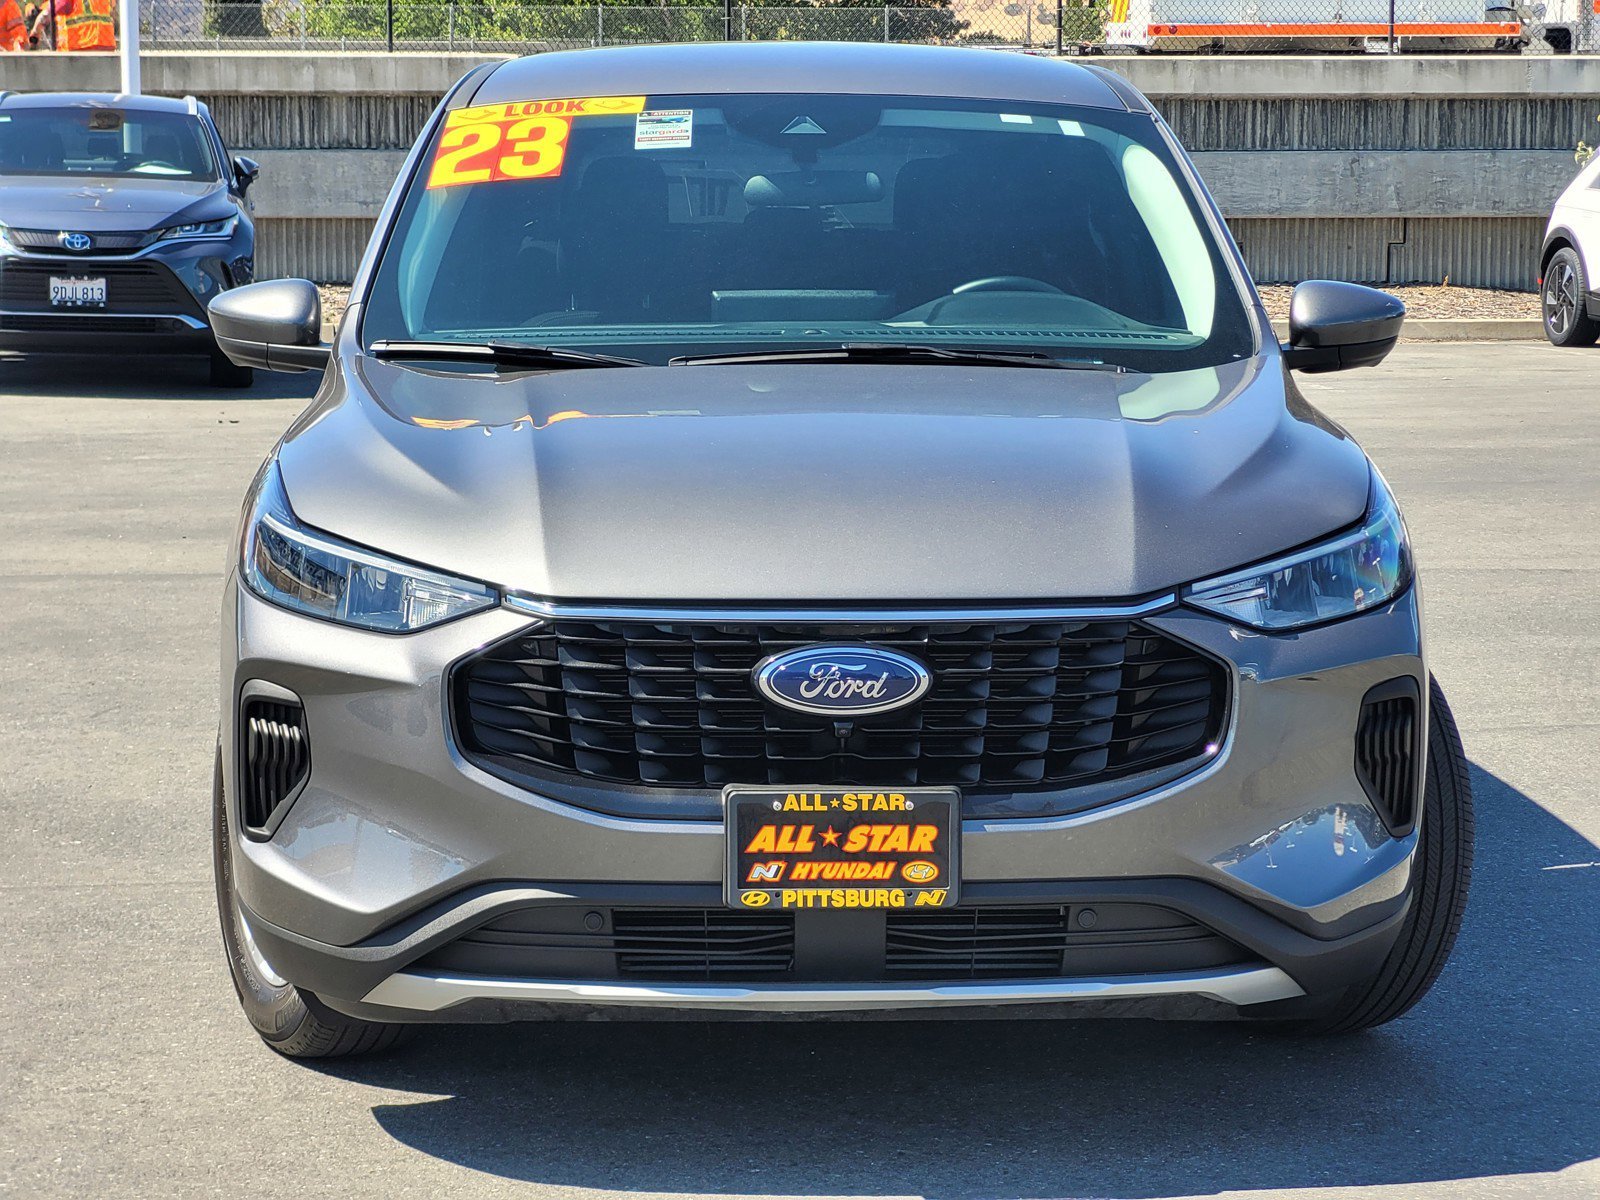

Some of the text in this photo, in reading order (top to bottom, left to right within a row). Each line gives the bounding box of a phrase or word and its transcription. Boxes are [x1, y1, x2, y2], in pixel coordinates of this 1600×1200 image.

[503, 99, 587, 118] LOOK
[429, 116, 569, 187] 23
[53, 286, 104, 301] 9DJL813
[800, 662, 889, 699] Ford
[783, 793, 906, 812] ALL STAR
[744, 824, 940, 854] ALL STAR
[789, 861, 898, 881] HYUNDAI
[782, 889, 906, 908] PITTSBURG
